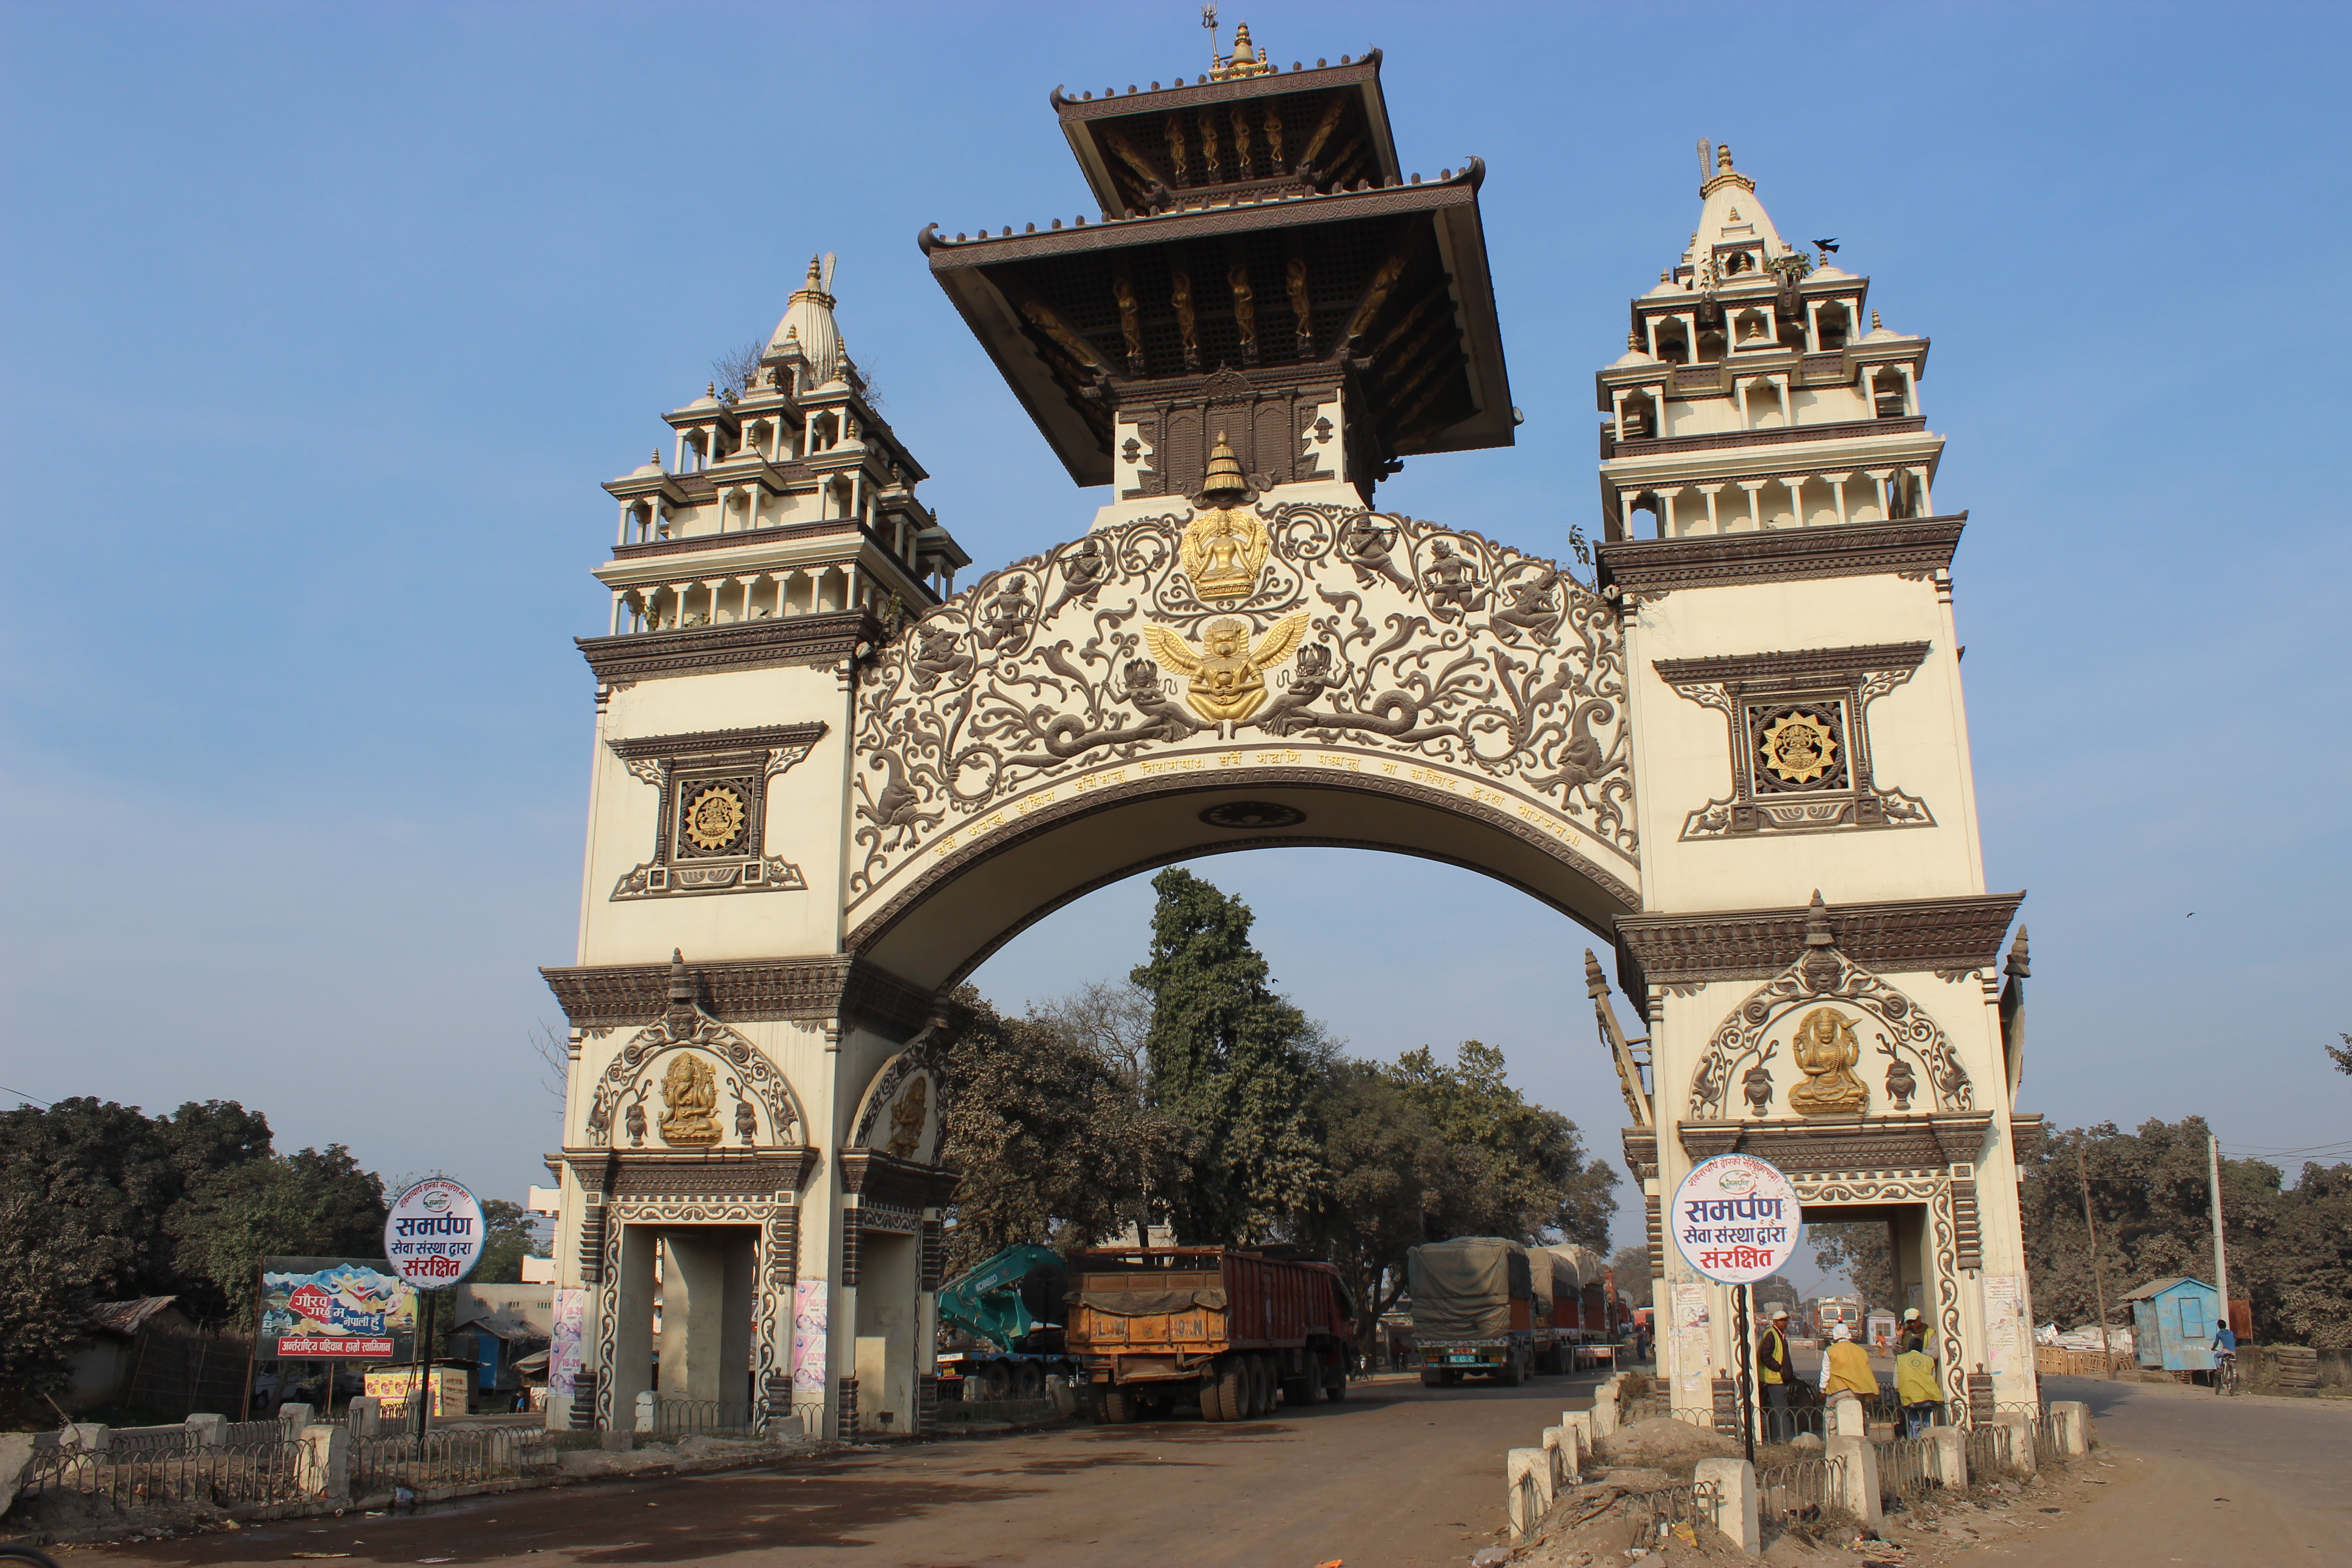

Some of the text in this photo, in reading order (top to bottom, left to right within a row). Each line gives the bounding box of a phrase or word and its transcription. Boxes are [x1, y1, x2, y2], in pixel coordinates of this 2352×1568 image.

[968, 812, 1007, 835] भवन्तु
[1256, 749, 1302, 764] भद्राणि
[1317, 753, 1360, 772] पश्यन्तु
[1382, 762, 1397, 775] मा
[1468, 785, 1505, 806] दुःख
[1687, 1159, 1719, 1187] शंकराचार्य
[1726, 1178, 1750, 1187] समर्पण
[399, 1183, 423, 1208] शंकराचार्य
[441, 1181, 460, 1194] संरक्षण
[429, 1198, 448, 1206] समर्पण
[1684, 1192, 1784, 1222] समर्पण
[396, 1211, 474, 1236] समर्पण
[1682, 1225, 1787, 1246] सेवा संस्था द्वारा
[391, 1239, 473, 1257] सेवा संस्था द्वारा
[1700, 1245, 1775, 1269] संरक्षित
[402, 1255, 461, 1278] संरक्षित
[975, 1274, 998, 1292] KOBELCO
[294, 1293, 328, 1307] गौरव
[306, 1305, 346, 1318] गर्छु म
[343, 1314, 381, 1331] नेपाली हुँ
[1170, 1319, 1205, 1335] HORN
[345, 1339, 360, 1353] हाम्रो
[362, 1339, 392, 1352] स्वाभिमान
[562, 1358, 580, 1367] 16 20
